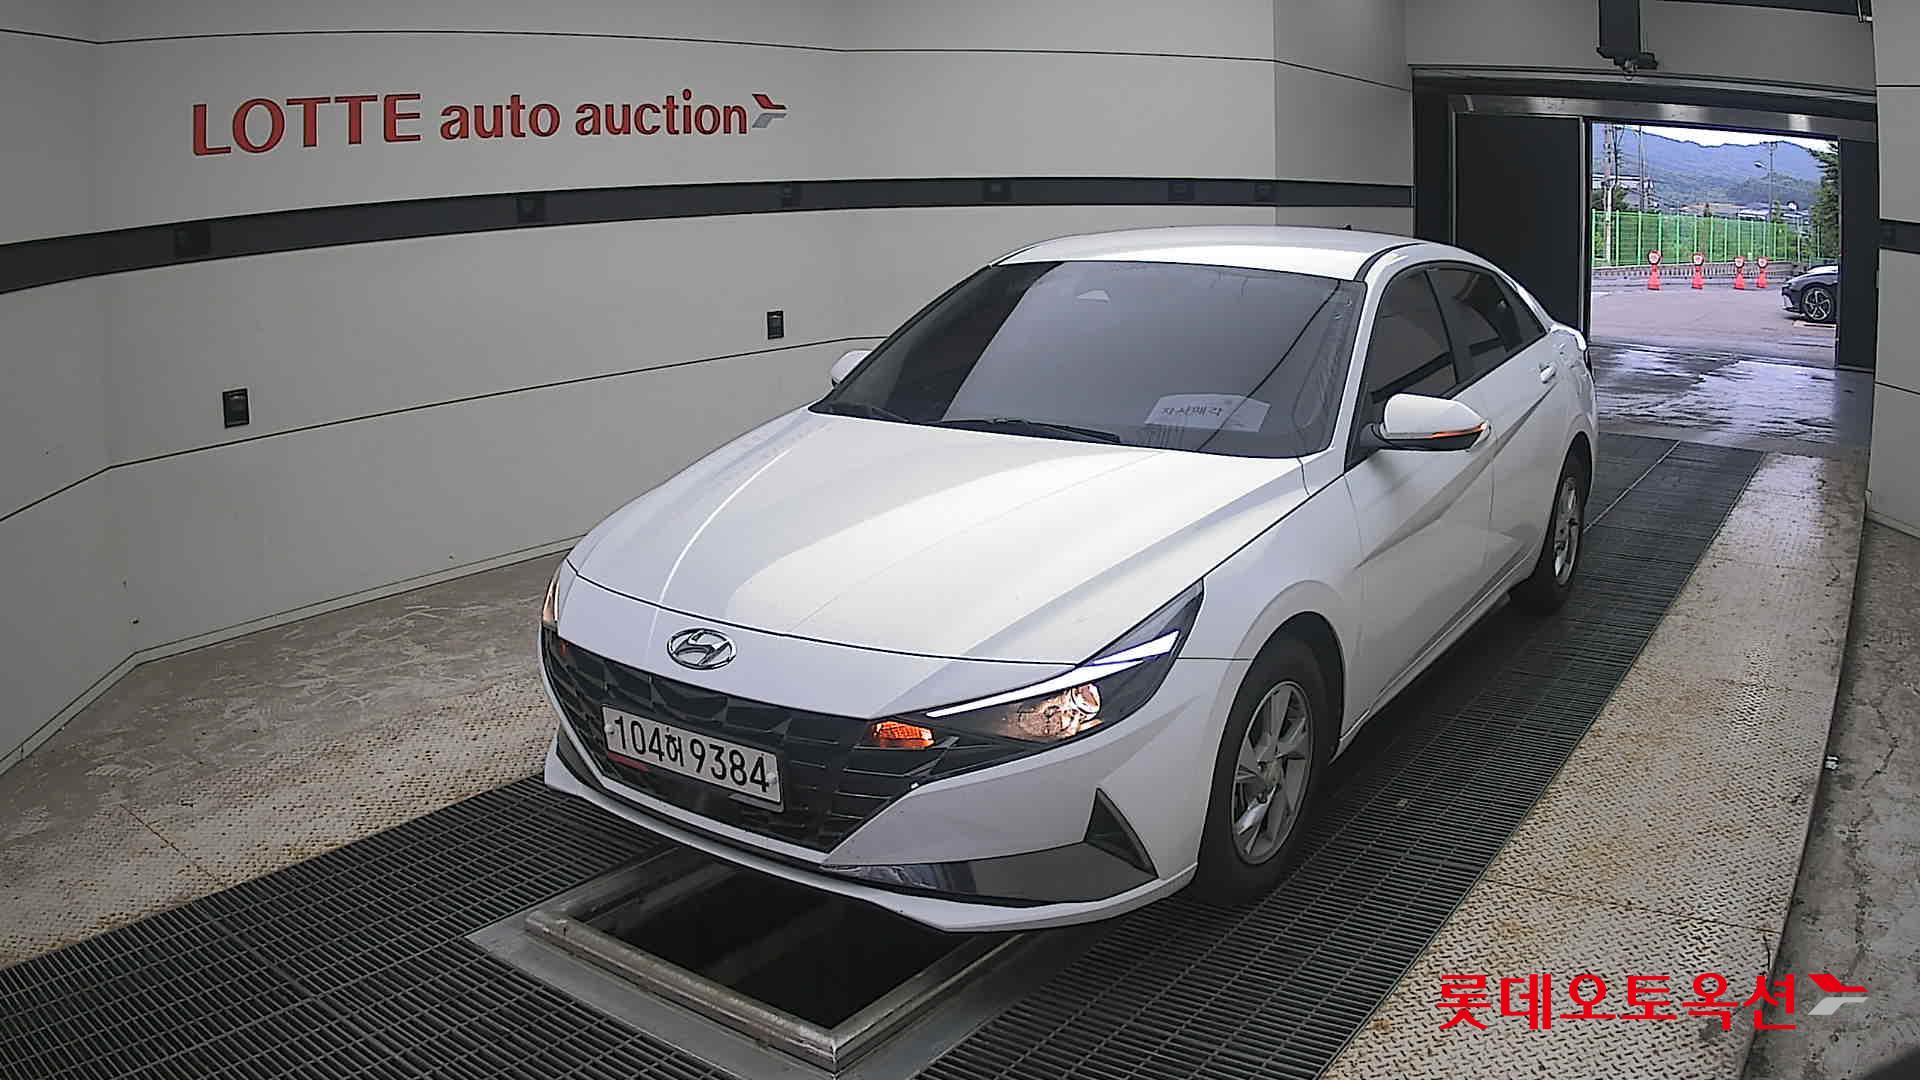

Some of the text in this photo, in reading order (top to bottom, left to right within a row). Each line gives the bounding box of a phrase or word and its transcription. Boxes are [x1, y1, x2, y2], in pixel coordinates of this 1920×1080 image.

[192, 88, 749, 156] LOTTE auto auction
